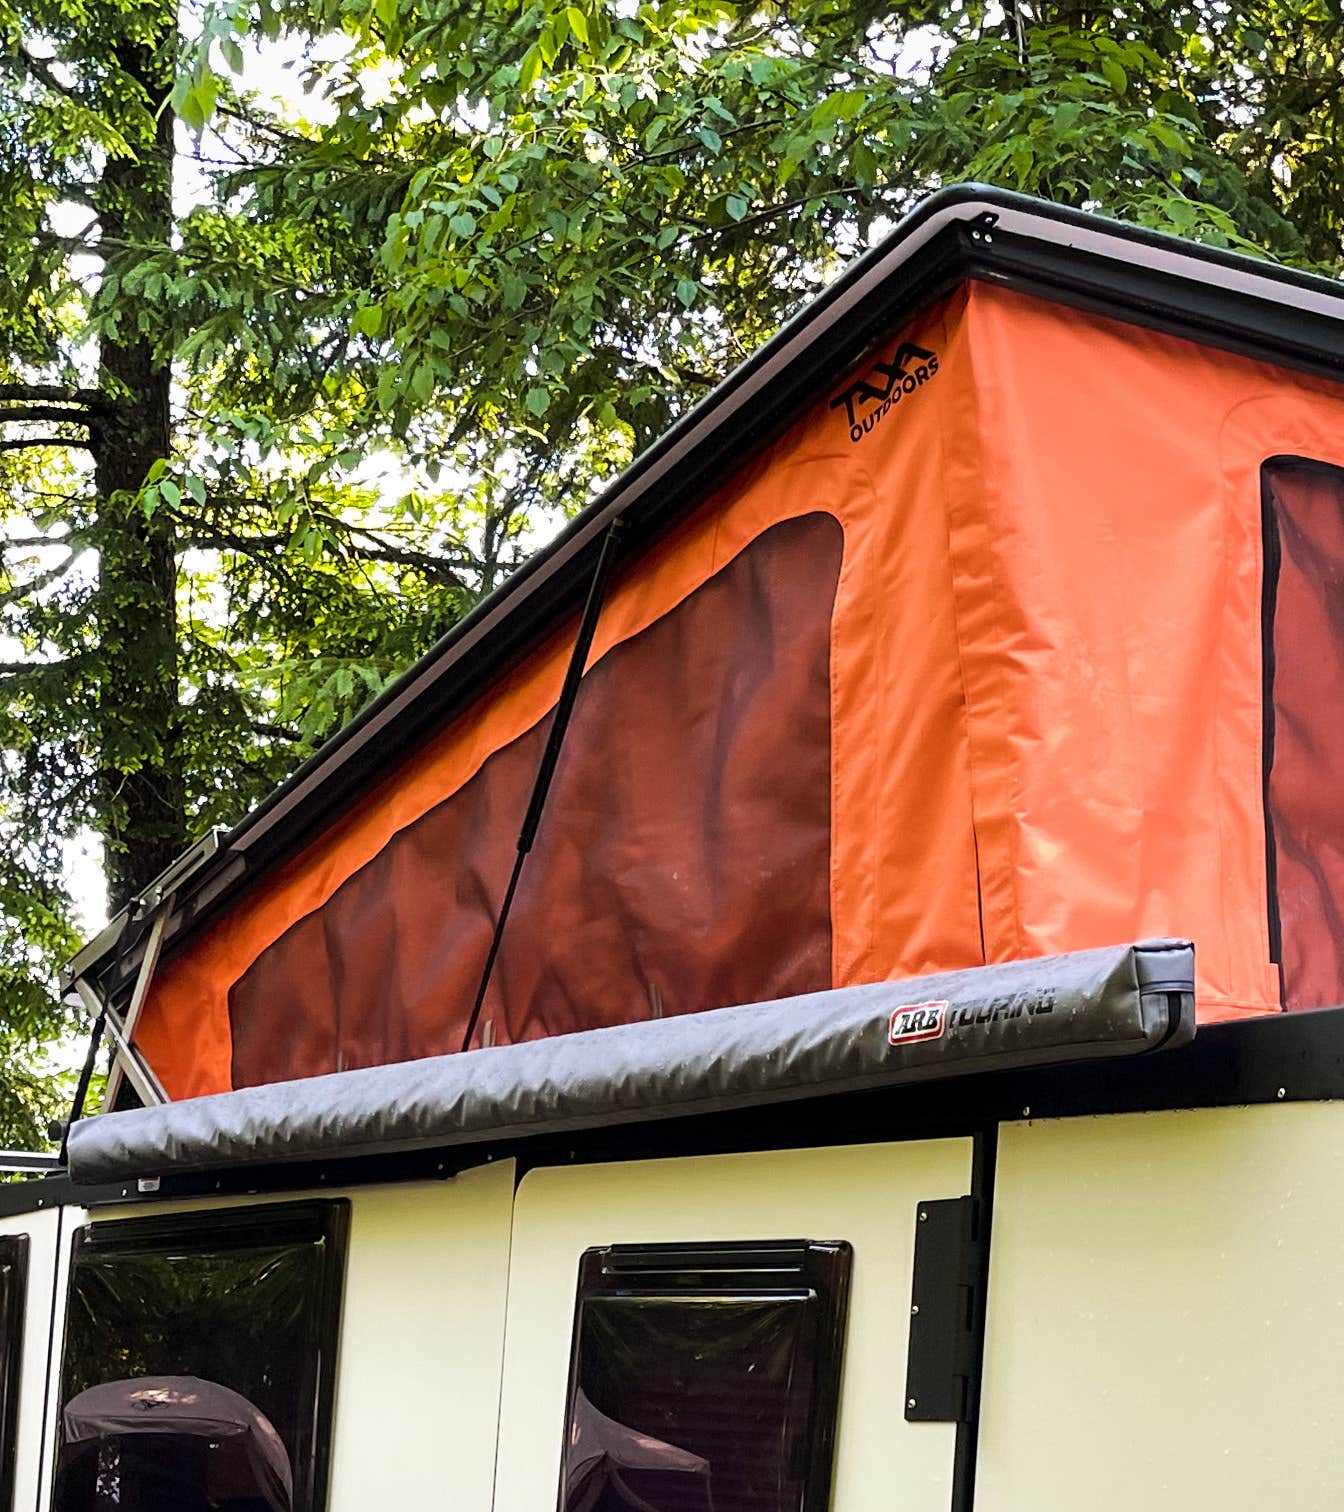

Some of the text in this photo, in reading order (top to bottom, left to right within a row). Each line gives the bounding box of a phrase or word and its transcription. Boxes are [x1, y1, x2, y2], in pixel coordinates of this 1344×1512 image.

[829, 342, 936, 427] TAXA
[850, 356, 939, 442] OUTDOORS
[894, 988, 1056, 1036] ARB TOURING
